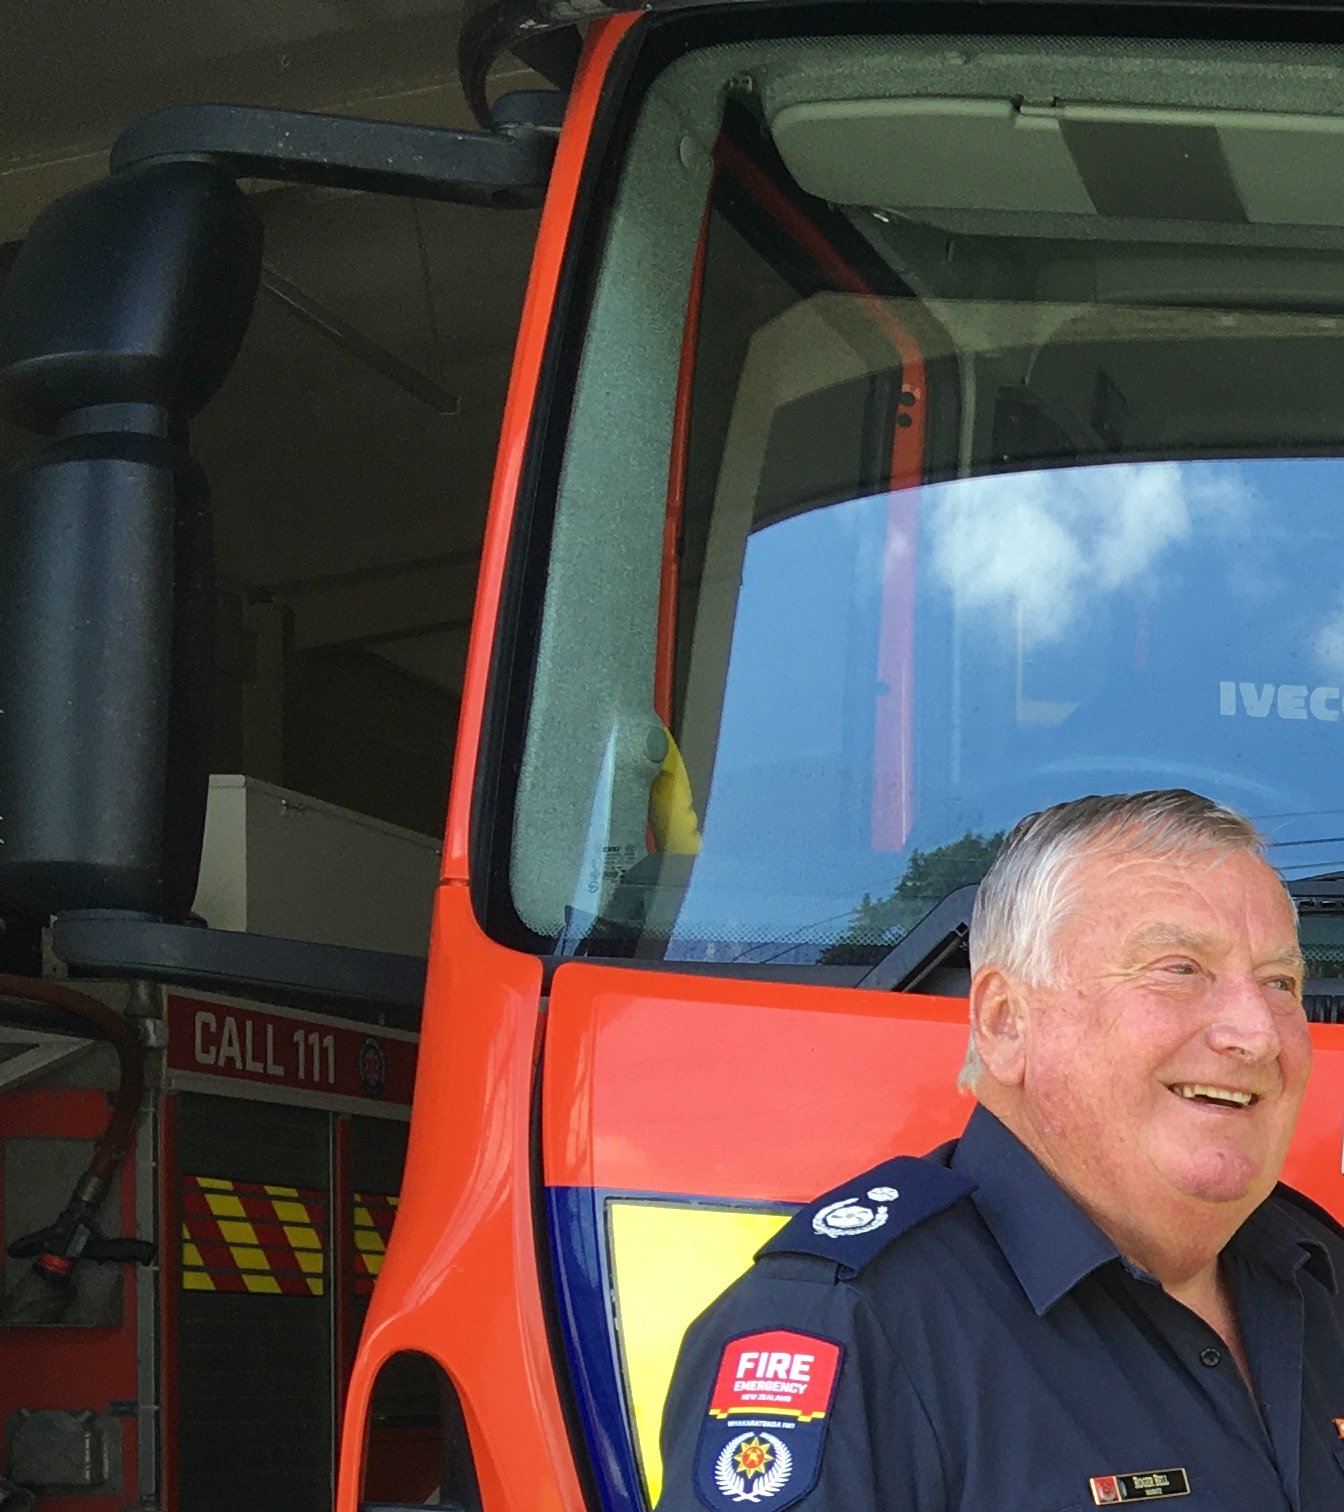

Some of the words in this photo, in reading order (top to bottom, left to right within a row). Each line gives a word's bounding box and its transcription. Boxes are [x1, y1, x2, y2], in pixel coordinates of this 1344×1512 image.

[194, 1010, 285, 1076] CALL
[293, 1030, 336, 1084] 111
[736, 1352, 814, 1381] FIRE
[733, 1380, 808, 1394] EMERGENCY
[758, 1394, 792, 1402] ZEALAND
